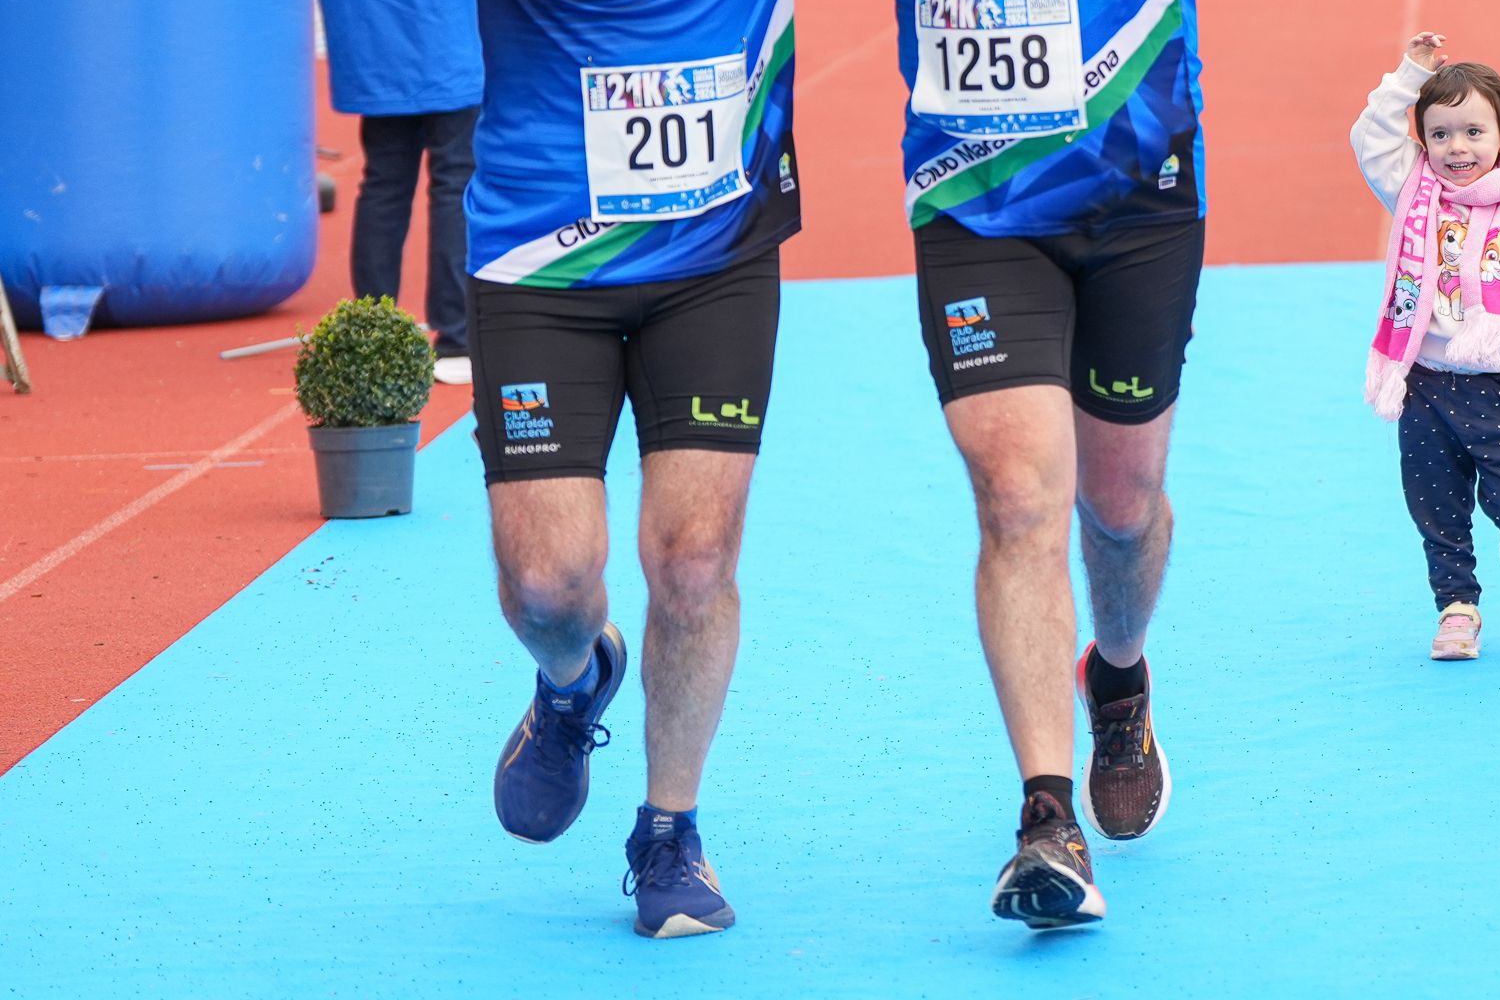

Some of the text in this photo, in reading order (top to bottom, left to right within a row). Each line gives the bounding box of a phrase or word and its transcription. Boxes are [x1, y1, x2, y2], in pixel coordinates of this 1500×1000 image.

[936, 34, 1050, 93] 1258
[606, 70, 665, 109] 21K
[625, 110, 716, 171] 201
[557, 221, 615, 248] Clu
[949, 326, 974, 339] Club
[951, 329, 997, 347] Maratón
[953, 340, 995, 356] Lucena
[503, 409, 531, 422] Club
[505, 416, 555, 430] Maratón
[506, 428, 551, 440] Lucena
